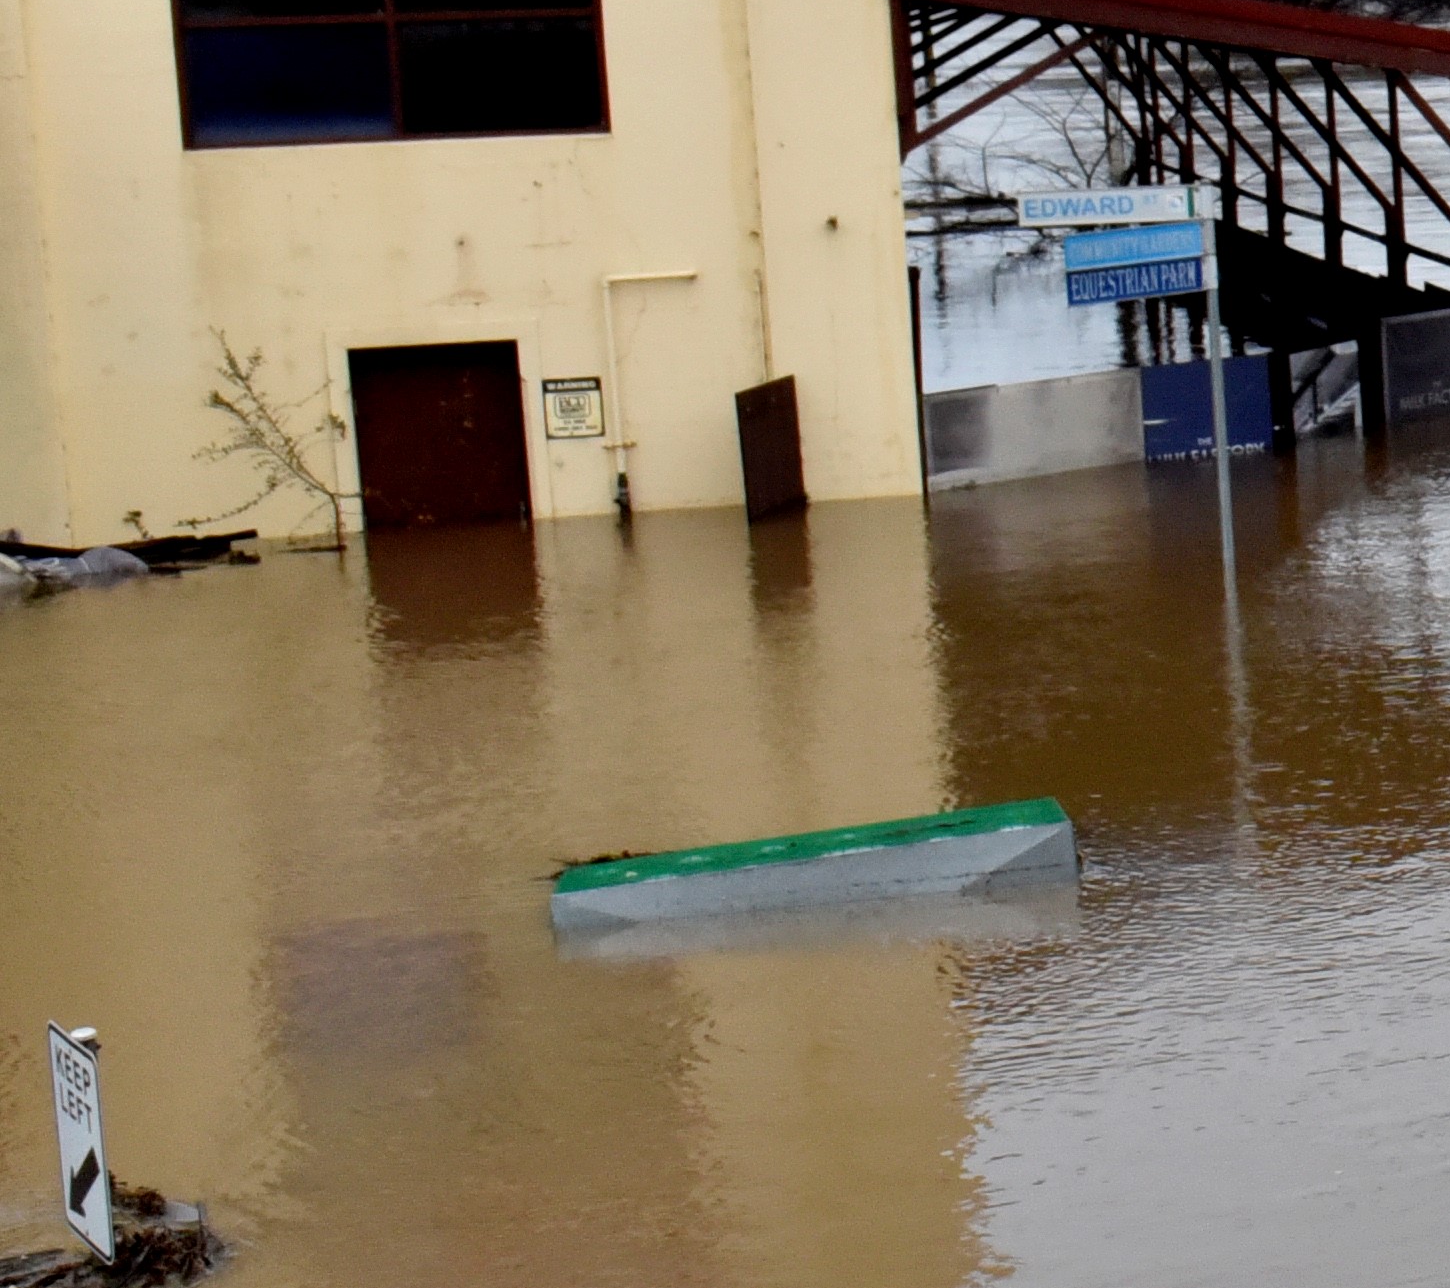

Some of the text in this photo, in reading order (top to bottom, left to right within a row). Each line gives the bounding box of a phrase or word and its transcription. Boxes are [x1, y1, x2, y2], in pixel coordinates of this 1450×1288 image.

[1024, 195, 1134, 219] EDWARD
[1070, 260, 1197, 301] EQUESTRIAN PARK
[55, 1045, 91, 1097] KEEP
[60, 1082, 92, 1134] LEFT
